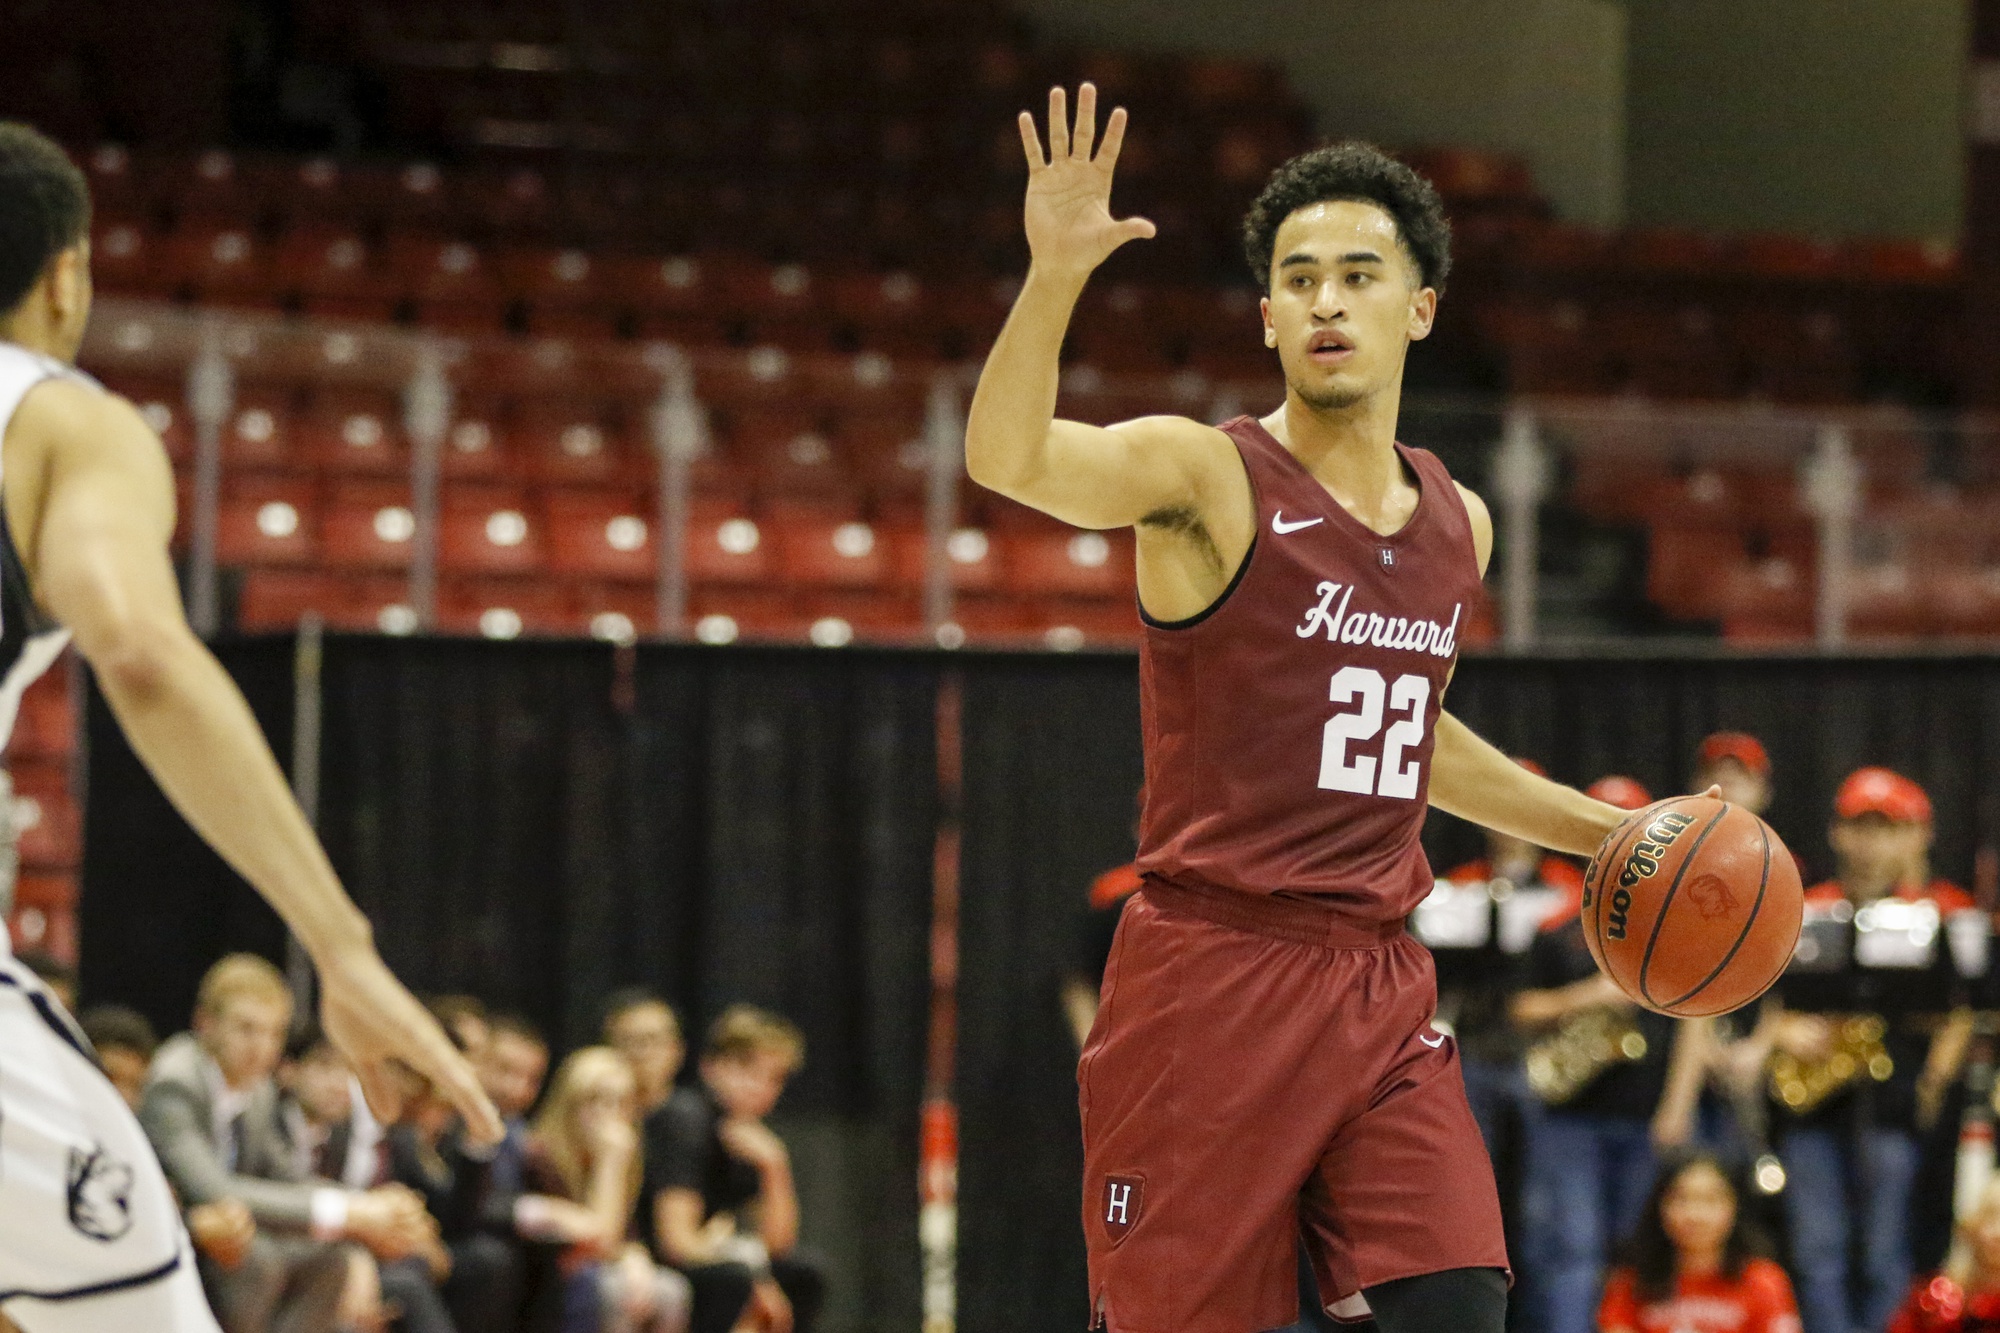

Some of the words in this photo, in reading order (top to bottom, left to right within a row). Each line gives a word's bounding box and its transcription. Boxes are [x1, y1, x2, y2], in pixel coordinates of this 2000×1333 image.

[1382, 549, 1393, 564] H
[1296, 580, 1462, 658] Harvard
[1317, 666, 1430, 799] 22
[1607, 811, 1698, 941] Wilson
[1107, 1184, 1131, 1225] H
